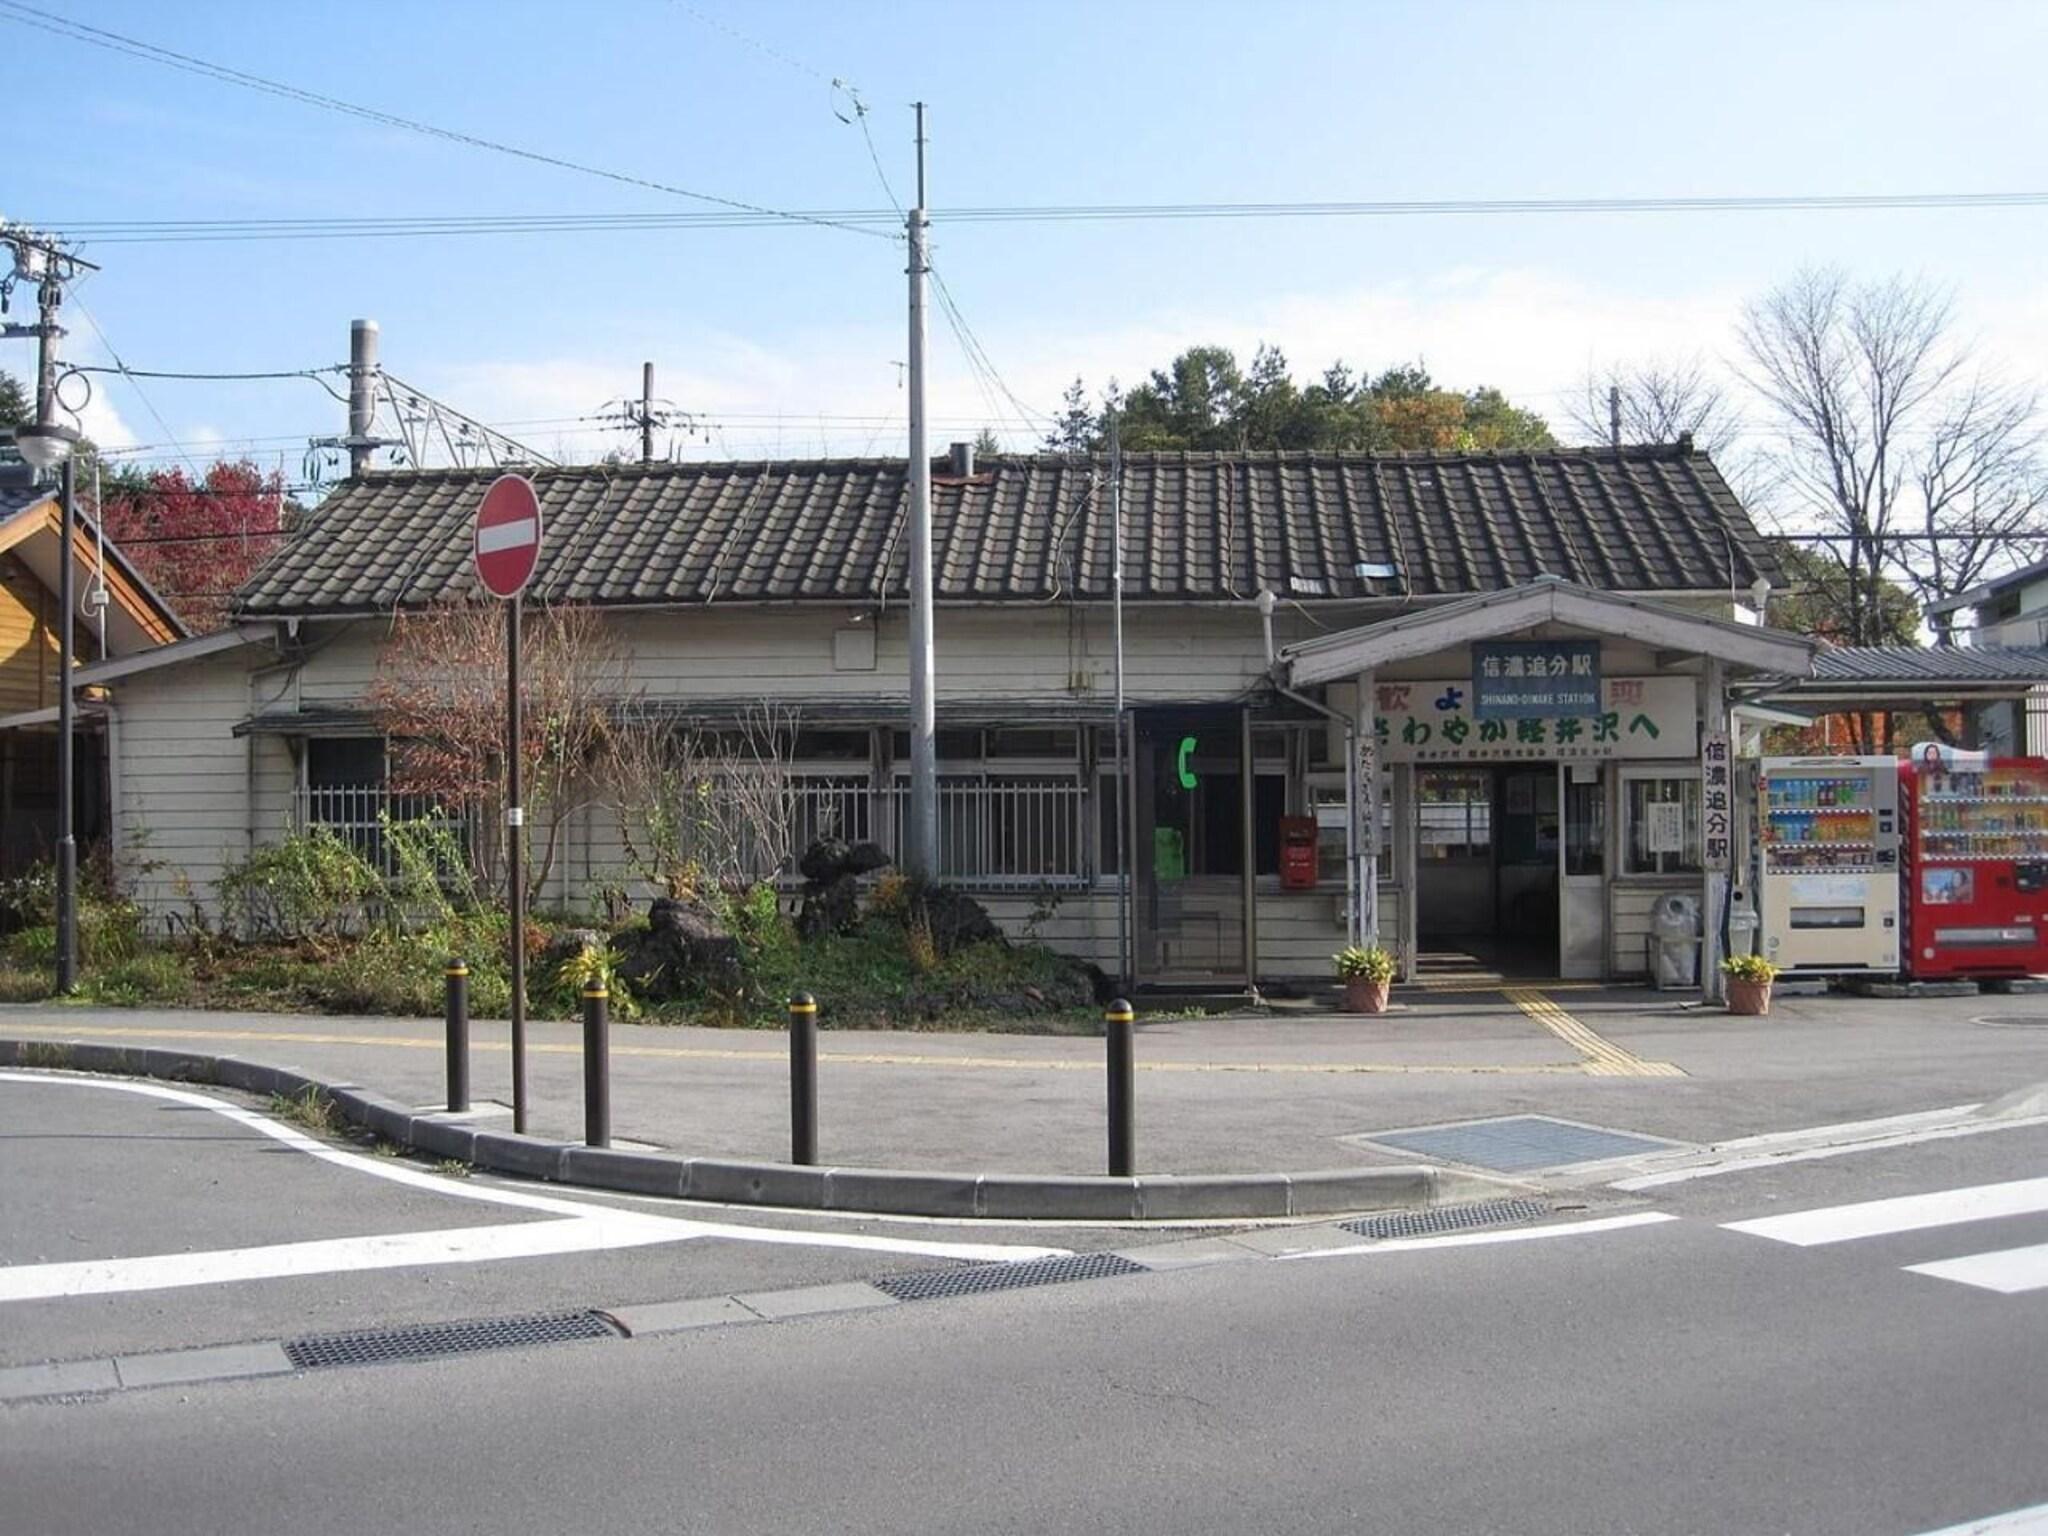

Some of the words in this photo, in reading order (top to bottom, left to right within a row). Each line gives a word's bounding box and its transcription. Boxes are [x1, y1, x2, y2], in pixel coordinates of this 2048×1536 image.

[1482, 653, 1592, 677] 信濃追分駅
[1556, 692, 1595, 704] STATION
[1704, 742, 1728, 858] 信濃追分駅
